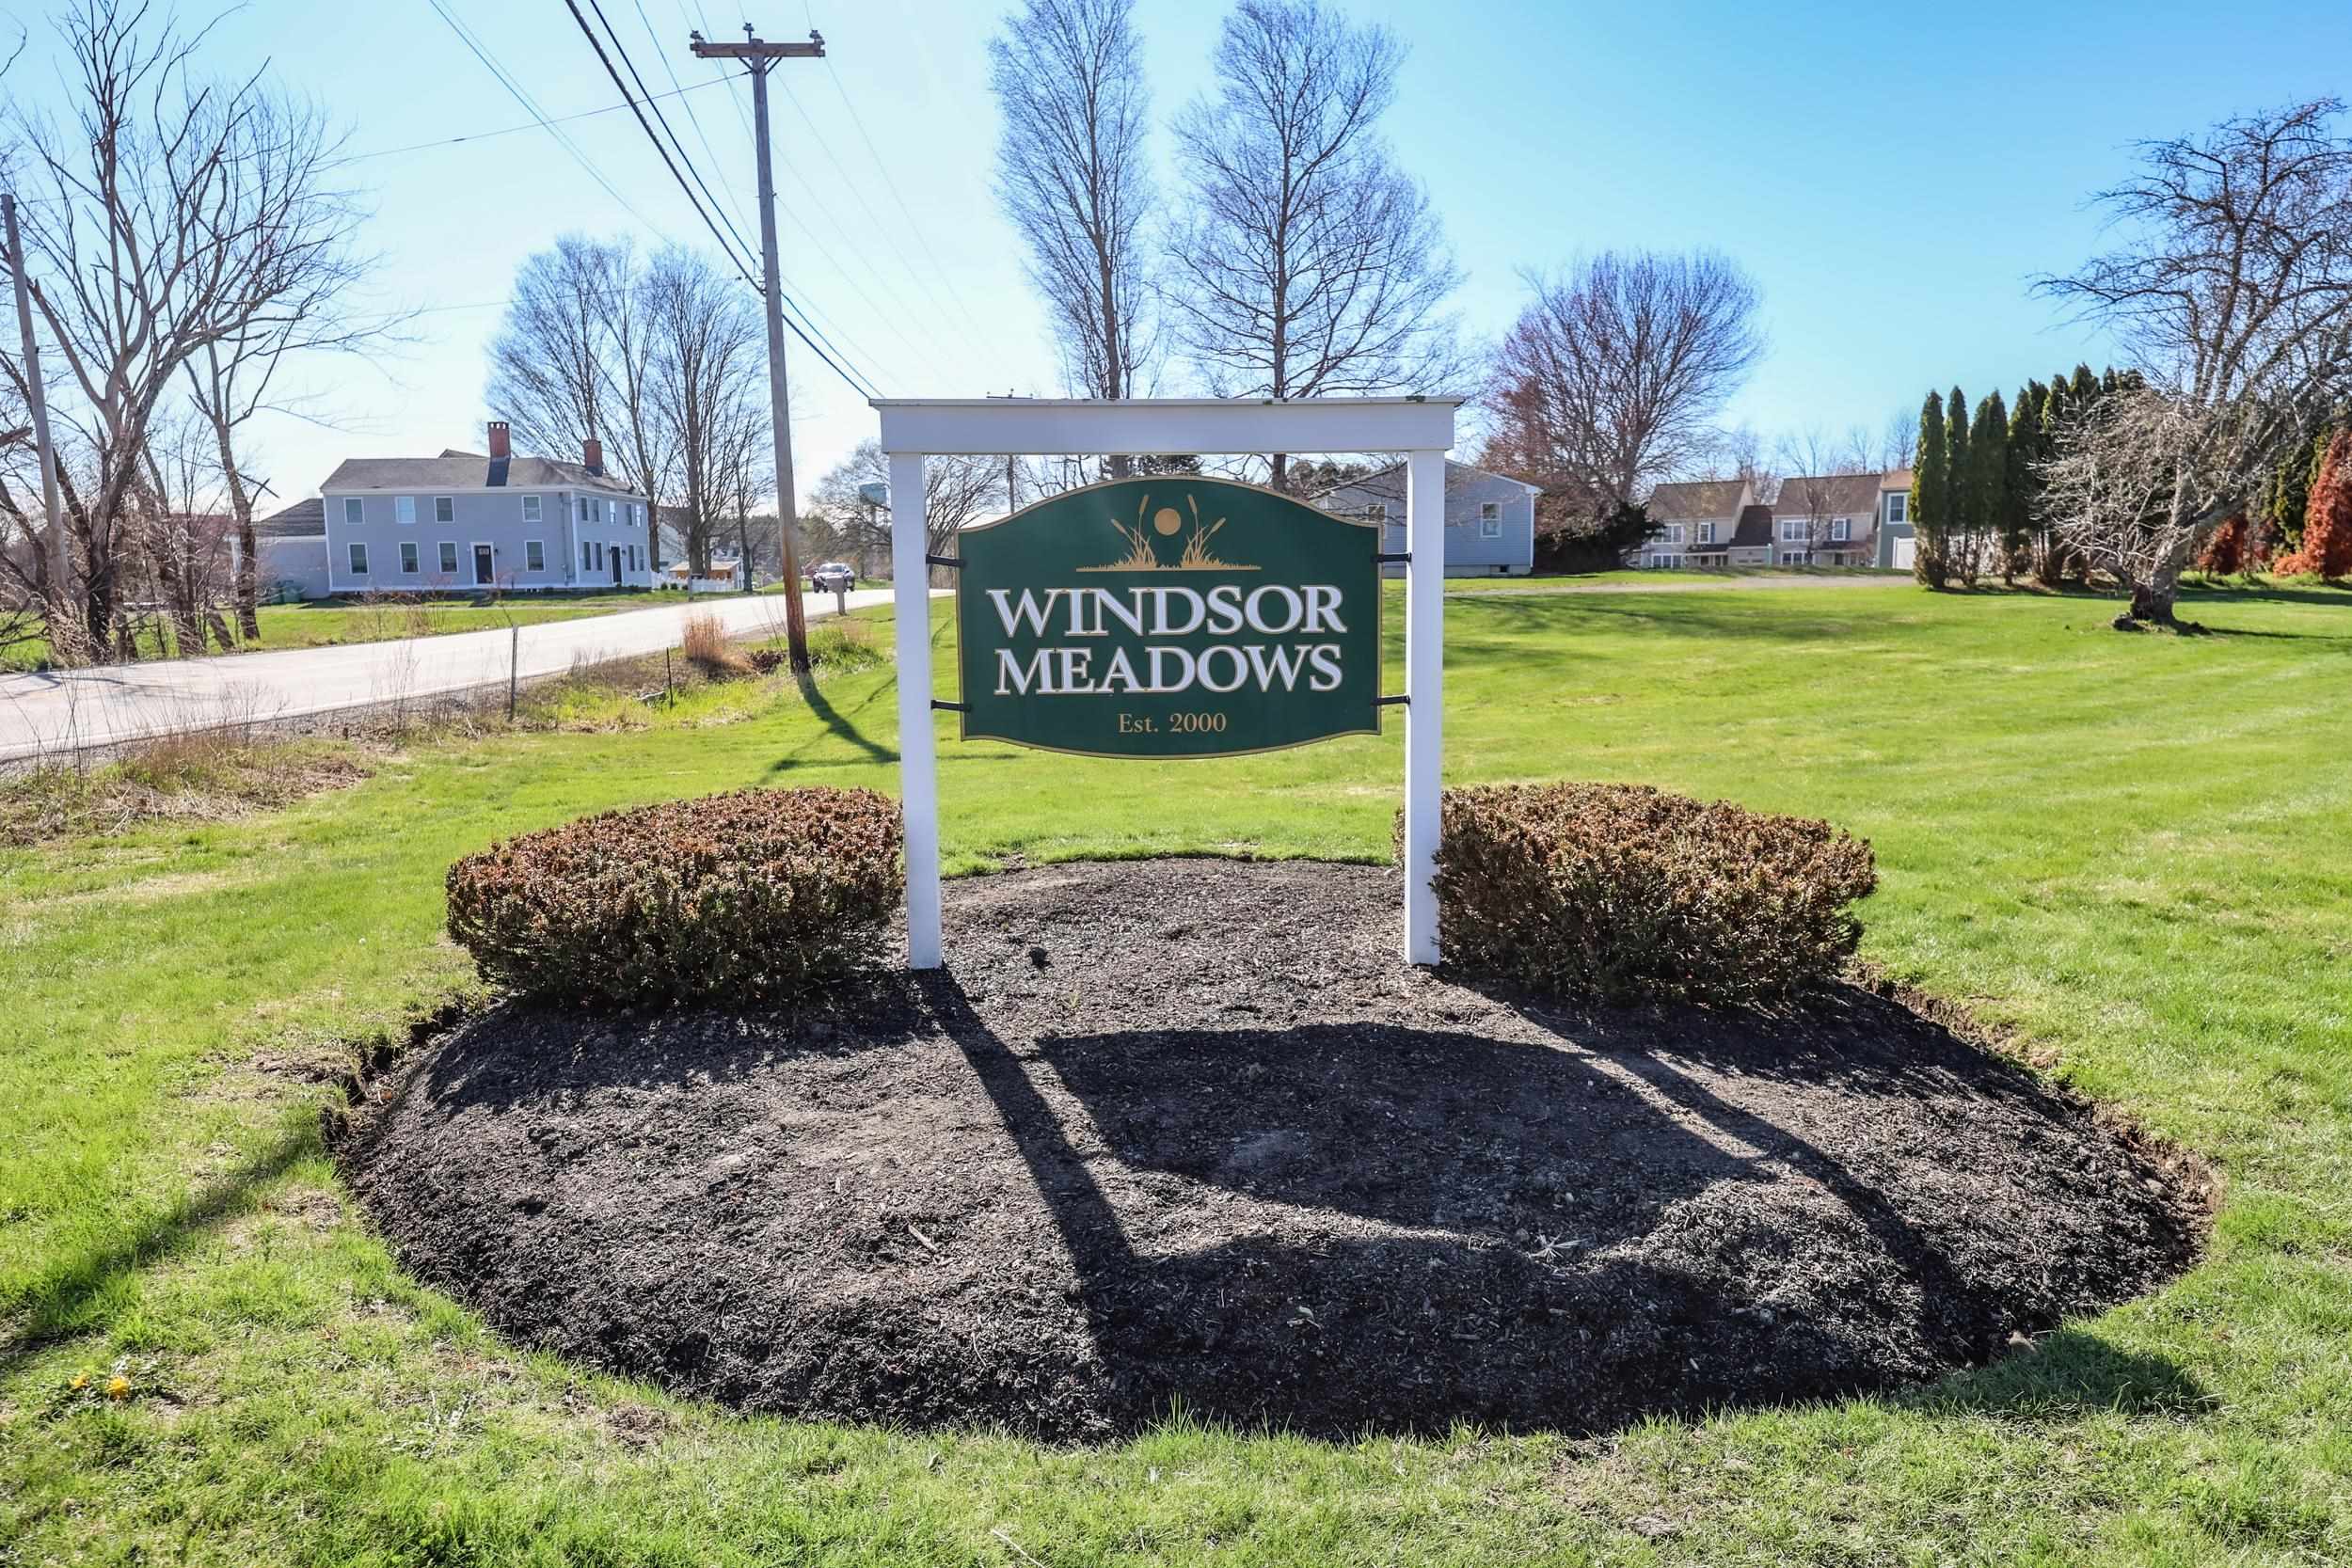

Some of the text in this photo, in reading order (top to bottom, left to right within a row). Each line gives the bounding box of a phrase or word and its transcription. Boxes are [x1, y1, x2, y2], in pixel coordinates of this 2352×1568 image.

[986, 585, 1347, 638] WINDSOR
[994, 644, 1343, 695] MEADOWS
[1119, 712, 1227, 734] Est. 2000
